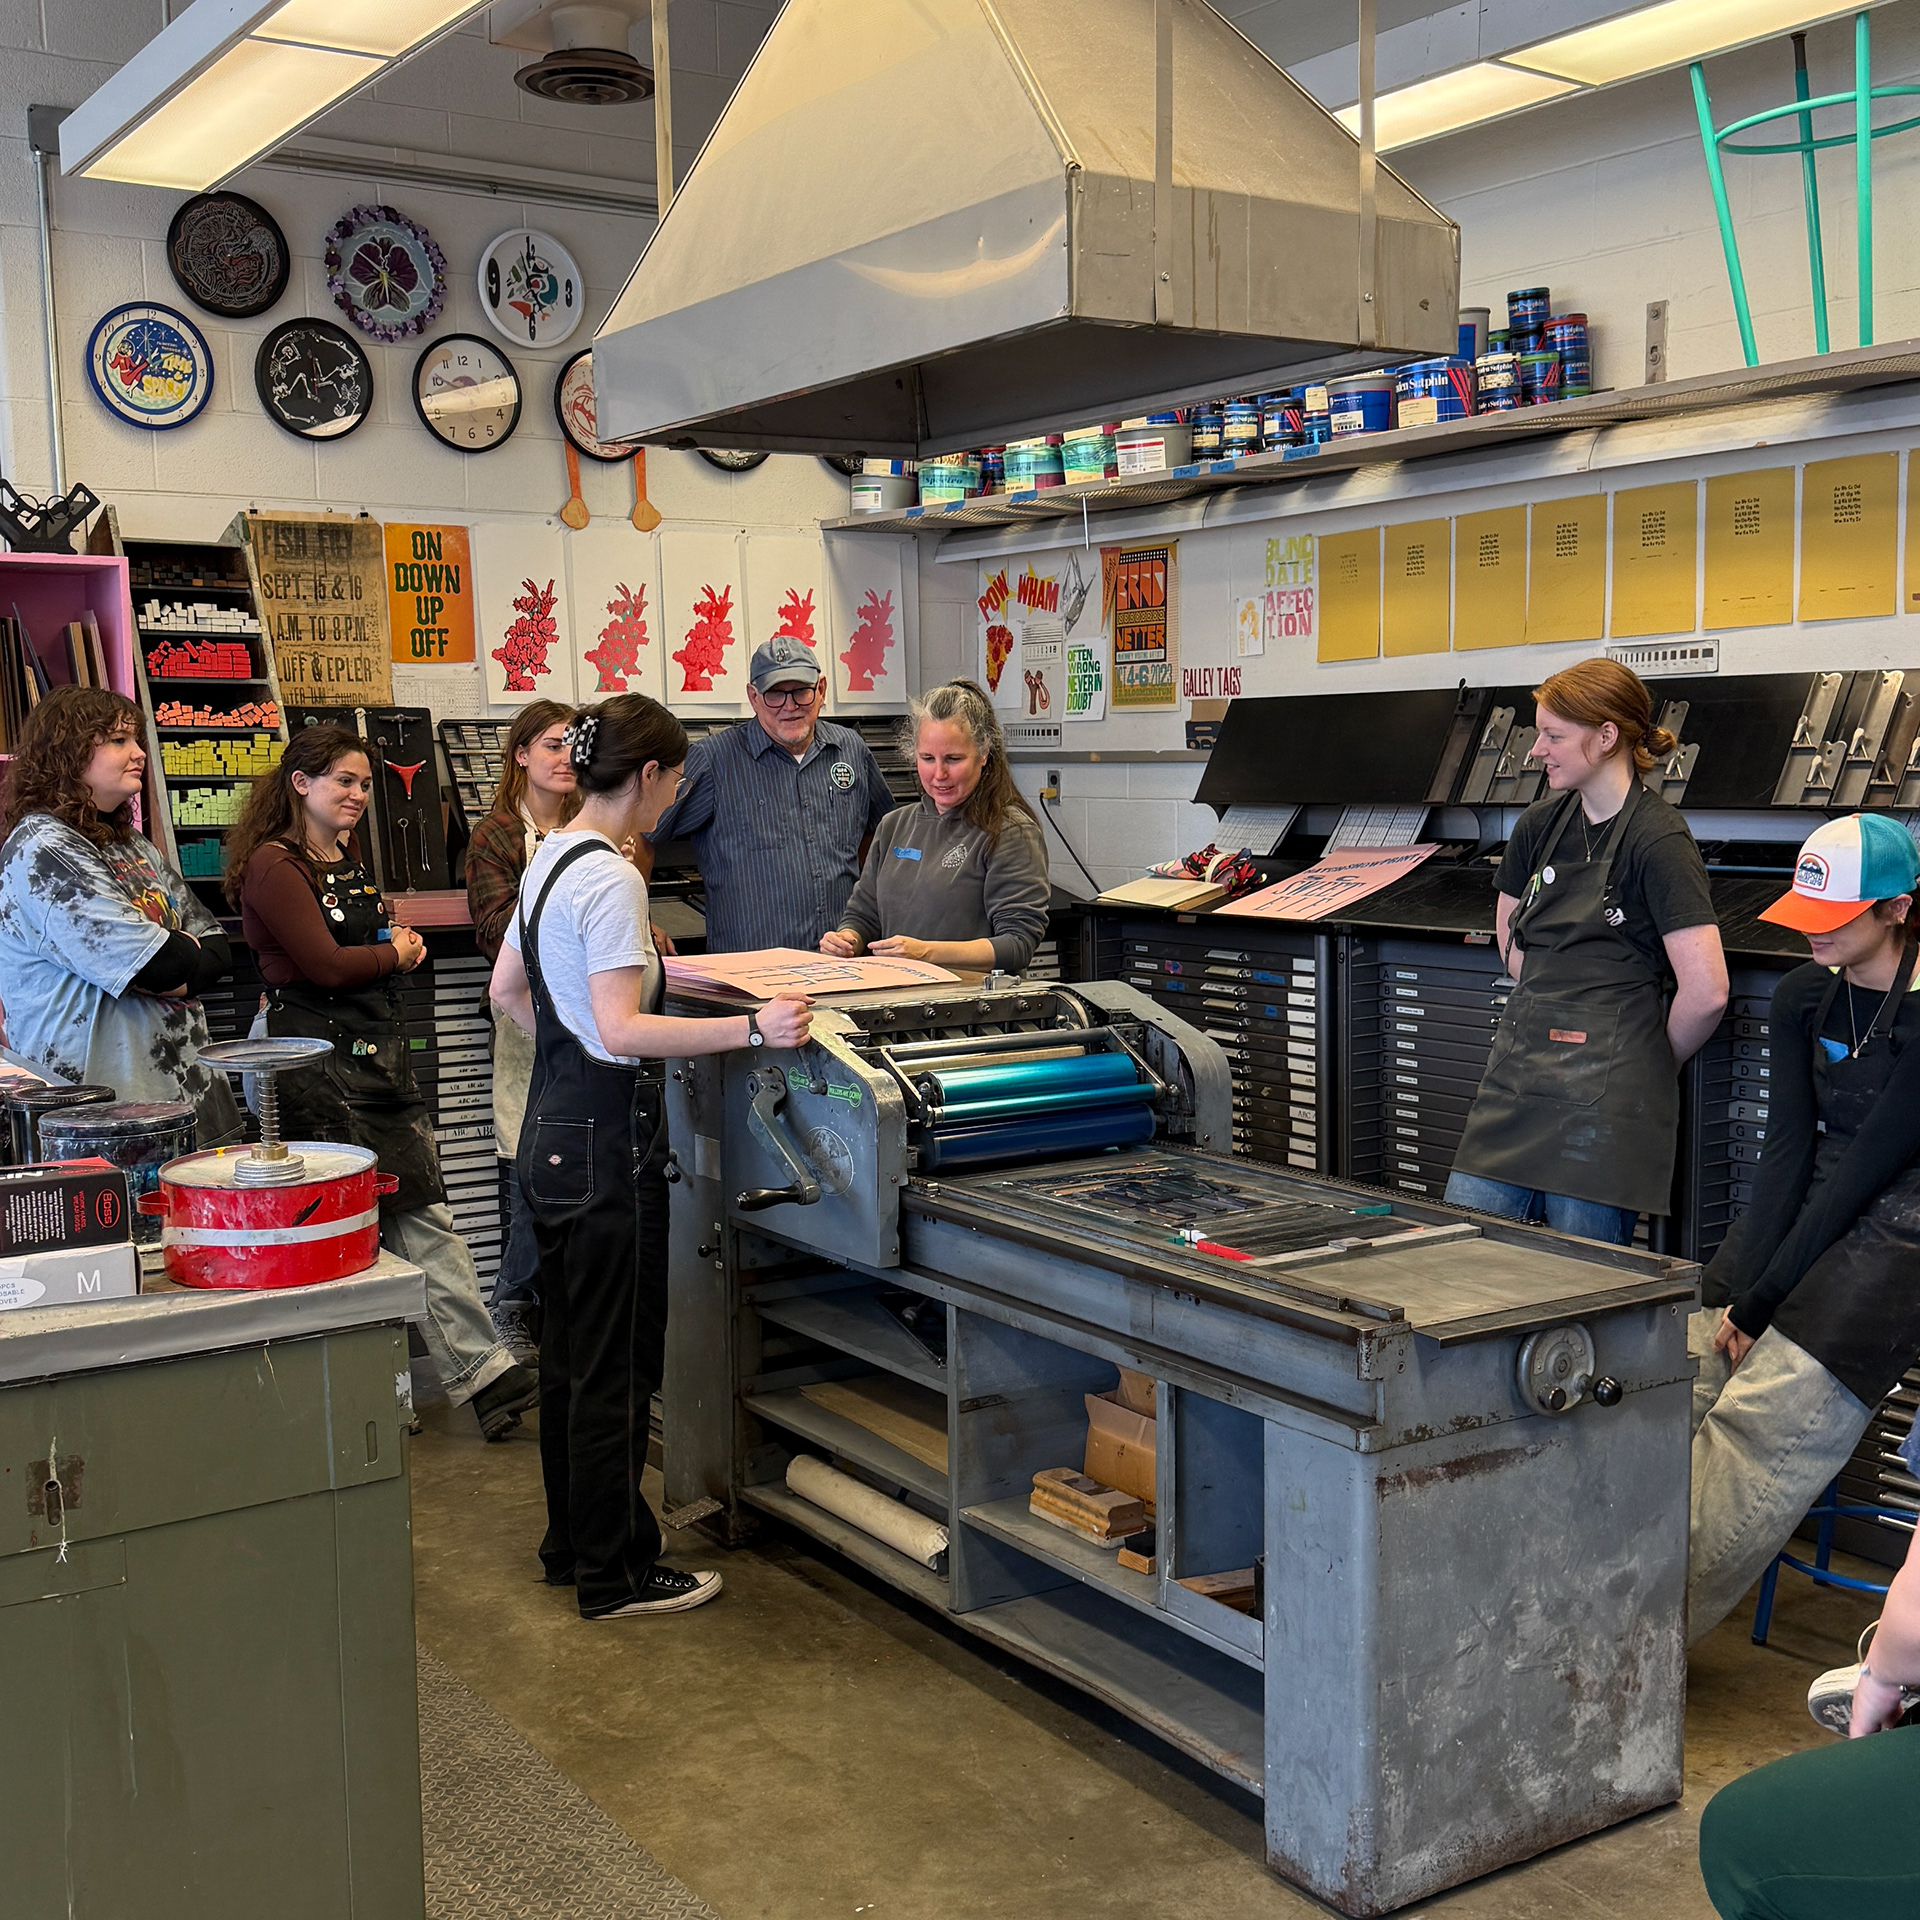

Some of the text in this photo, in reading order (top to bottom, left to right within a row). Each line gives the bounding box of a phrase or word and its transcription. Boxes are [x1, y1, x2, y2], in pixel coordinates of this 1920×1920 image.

[487, 257, 500, 309] 9
[565, 278, 573, 308] 3
[122, 312, 130, 322] 11
[146, 310, 156, 319] 12
[104, 324, 114, 337] 10
[176, 321, 180, 329] 1
[529, 312, 536, 341] 6
[192, 340, 198, 348] 2
[95, 354, 101, 362] 9
[457, 356, 468, 366] 12
[478, 359, 482, 368] 1
[442, 359, 449, 369] 11
[200, 369, 205, 378] 3
[100, 381, 106, 390] 8
[433, 376, 443, 386] 10
[1409, 373, 1448, 389] Sutphin
[193, 394, 198, 402] 4
[500, 392, 507, 403] 3
[178, 410, 184, 418] 5
[434, 408, 442, 420] 8
[496, 408, 504, 420] 4
[147, 416, 152, 425] 6
[449, 426, 456, 438] 7
[468, 427, 476, 439] 6
[486, 425, 494, 436] 5
[925, 474, 963, 485] spectro
[411, 531, 442, 561] ON
[1266, 535, 1314, 562] BLIND
[394, 563, 460, 594] DOWN
[1266, 561, 1313, 585] DATE
[262, 573, 362, 601] SEPT. 15 & 16
[978, 569, 1009, 623] POW
[1017, 574, 1059, 613] WHAM
[416, 596, 443, 625] UP
[309, 615, 326, 641] TO
[333, 616, 341, 641] 8
[344, 616, 369, 642] P.M.
[410, 628, 449, 657] OFF
[1116, 624, 1165, 650] VETTER
[1067, 649, 1093, 661] OFTEN
[311, 650, 322, 682] &
[327, 656, 372, 683] EPLER
[1068, 660, 1100, 674] WRONG
[1150, 663, 1172, 684] 2023
[1067, 673, 1102, 692] NEVER IN
[1182, 666, 1241, 698] GALLEY TAGS
[1066, 692, 1093, 711] DOUBT
[1271, 880, 1367, 898] SWEET
[1339, 952, 1345, 963] 9
[1383, 970, 1389, 979] A
[1384, 986, 1390, 995] B
[1384, 1003, 1390, 1013] C
[1742, 1004, 1750, 1015] A
[1384, 1020, 1391, 1029] D
[1742, 1023, 1750, 1034] B
[1382, 1038, 1387, 1047] E
[1741, 1044, 1749, 1056] C
[1383, 1055, 1388, 1065] F
[1741, 1065, 1749, 1076] D
[1381, 1072, 1388, 1082] G
[1386, 1091, 1392, 1100] H
[1739, 1085, 1746, 1096] E
[1298, 1110, 1311, 1119] ABC
[1738, 1107, 1745, 1117] F
[476, 1125, 496, 1137] ABC
[1736, 1125, 1745, 1137] G
[1383, 1141, 1389, 1151] K
[1735, 1146, 1743, 1157] H
[1737, 1167, 1740, 1177] I
[1733, 1187, 1739, 1197] J
[103, 1193, 112, 1224] BOSS
[1734, 1207, 1742, 1217] K
[77, 1270, 101, 1294] M
